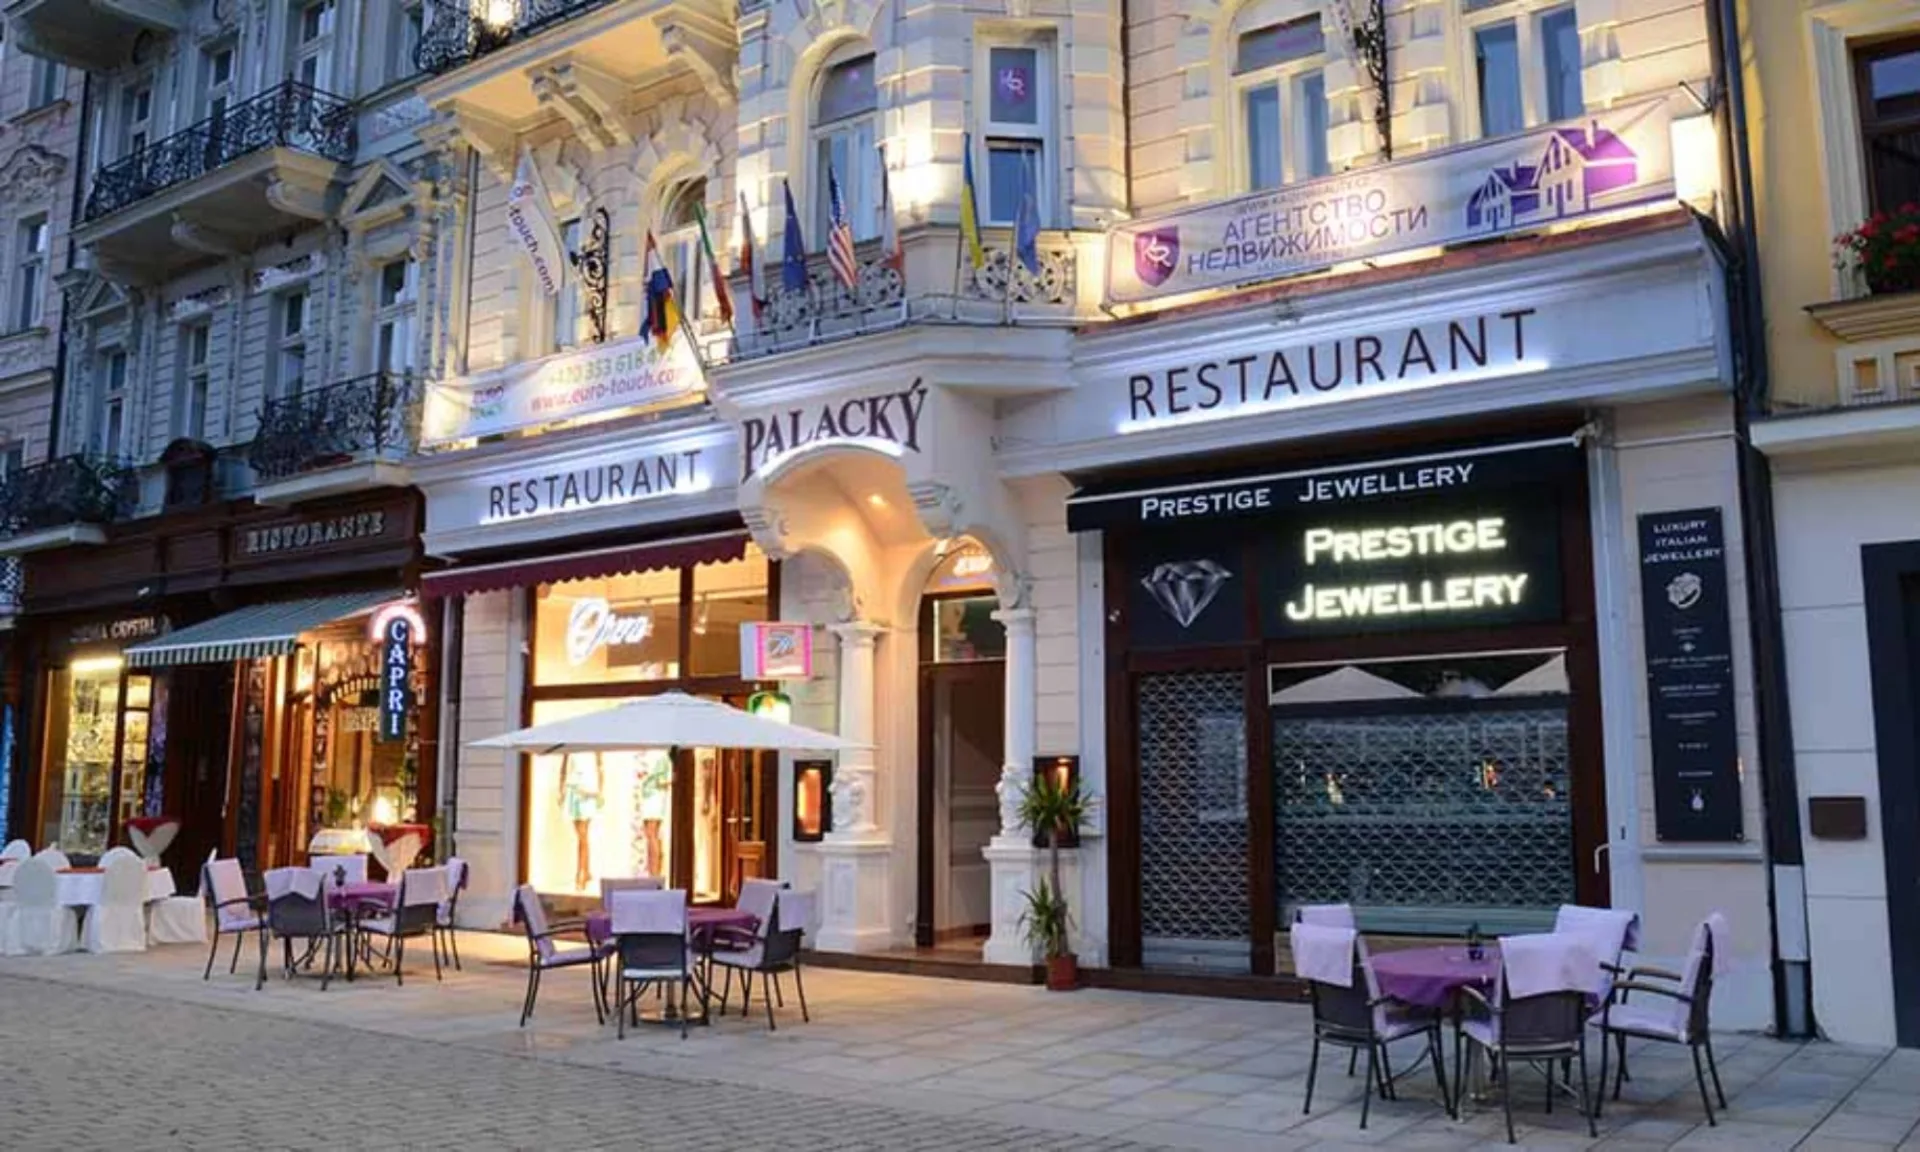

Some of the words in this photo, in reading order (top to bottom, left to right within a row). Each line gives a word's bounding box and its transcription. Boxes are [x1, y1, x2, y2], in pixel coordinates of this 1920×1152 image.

[1187, 204, 1429, 275] НЕДВИЖИМОСТИ
[1223, 188, 1386, 244] АГЕНТСТВО
[1128, 308, 1537, 421] RESTAURANT
[741, 376, 929, 484] PALACKÝ
[489, 450, 703, 518] RESTAURANT
[1141, 488, 1272, 520] PRESTIGE
[1298, 463, 1475, 502] JEWELLERY
[246, 510, 385, 554] RISTORANTE
[1304, 516, 1508, 566] PRESTIGE
[1653, 520, 1707, 534] LUXURY
[1655, 535, 1708, 548] ITALIAN
[1643, 548, 1721, 564] JEWELLERY
[1285, 572, 1529, 622] JEWELLERY
[387, 619, 408, 735] CAPRI
